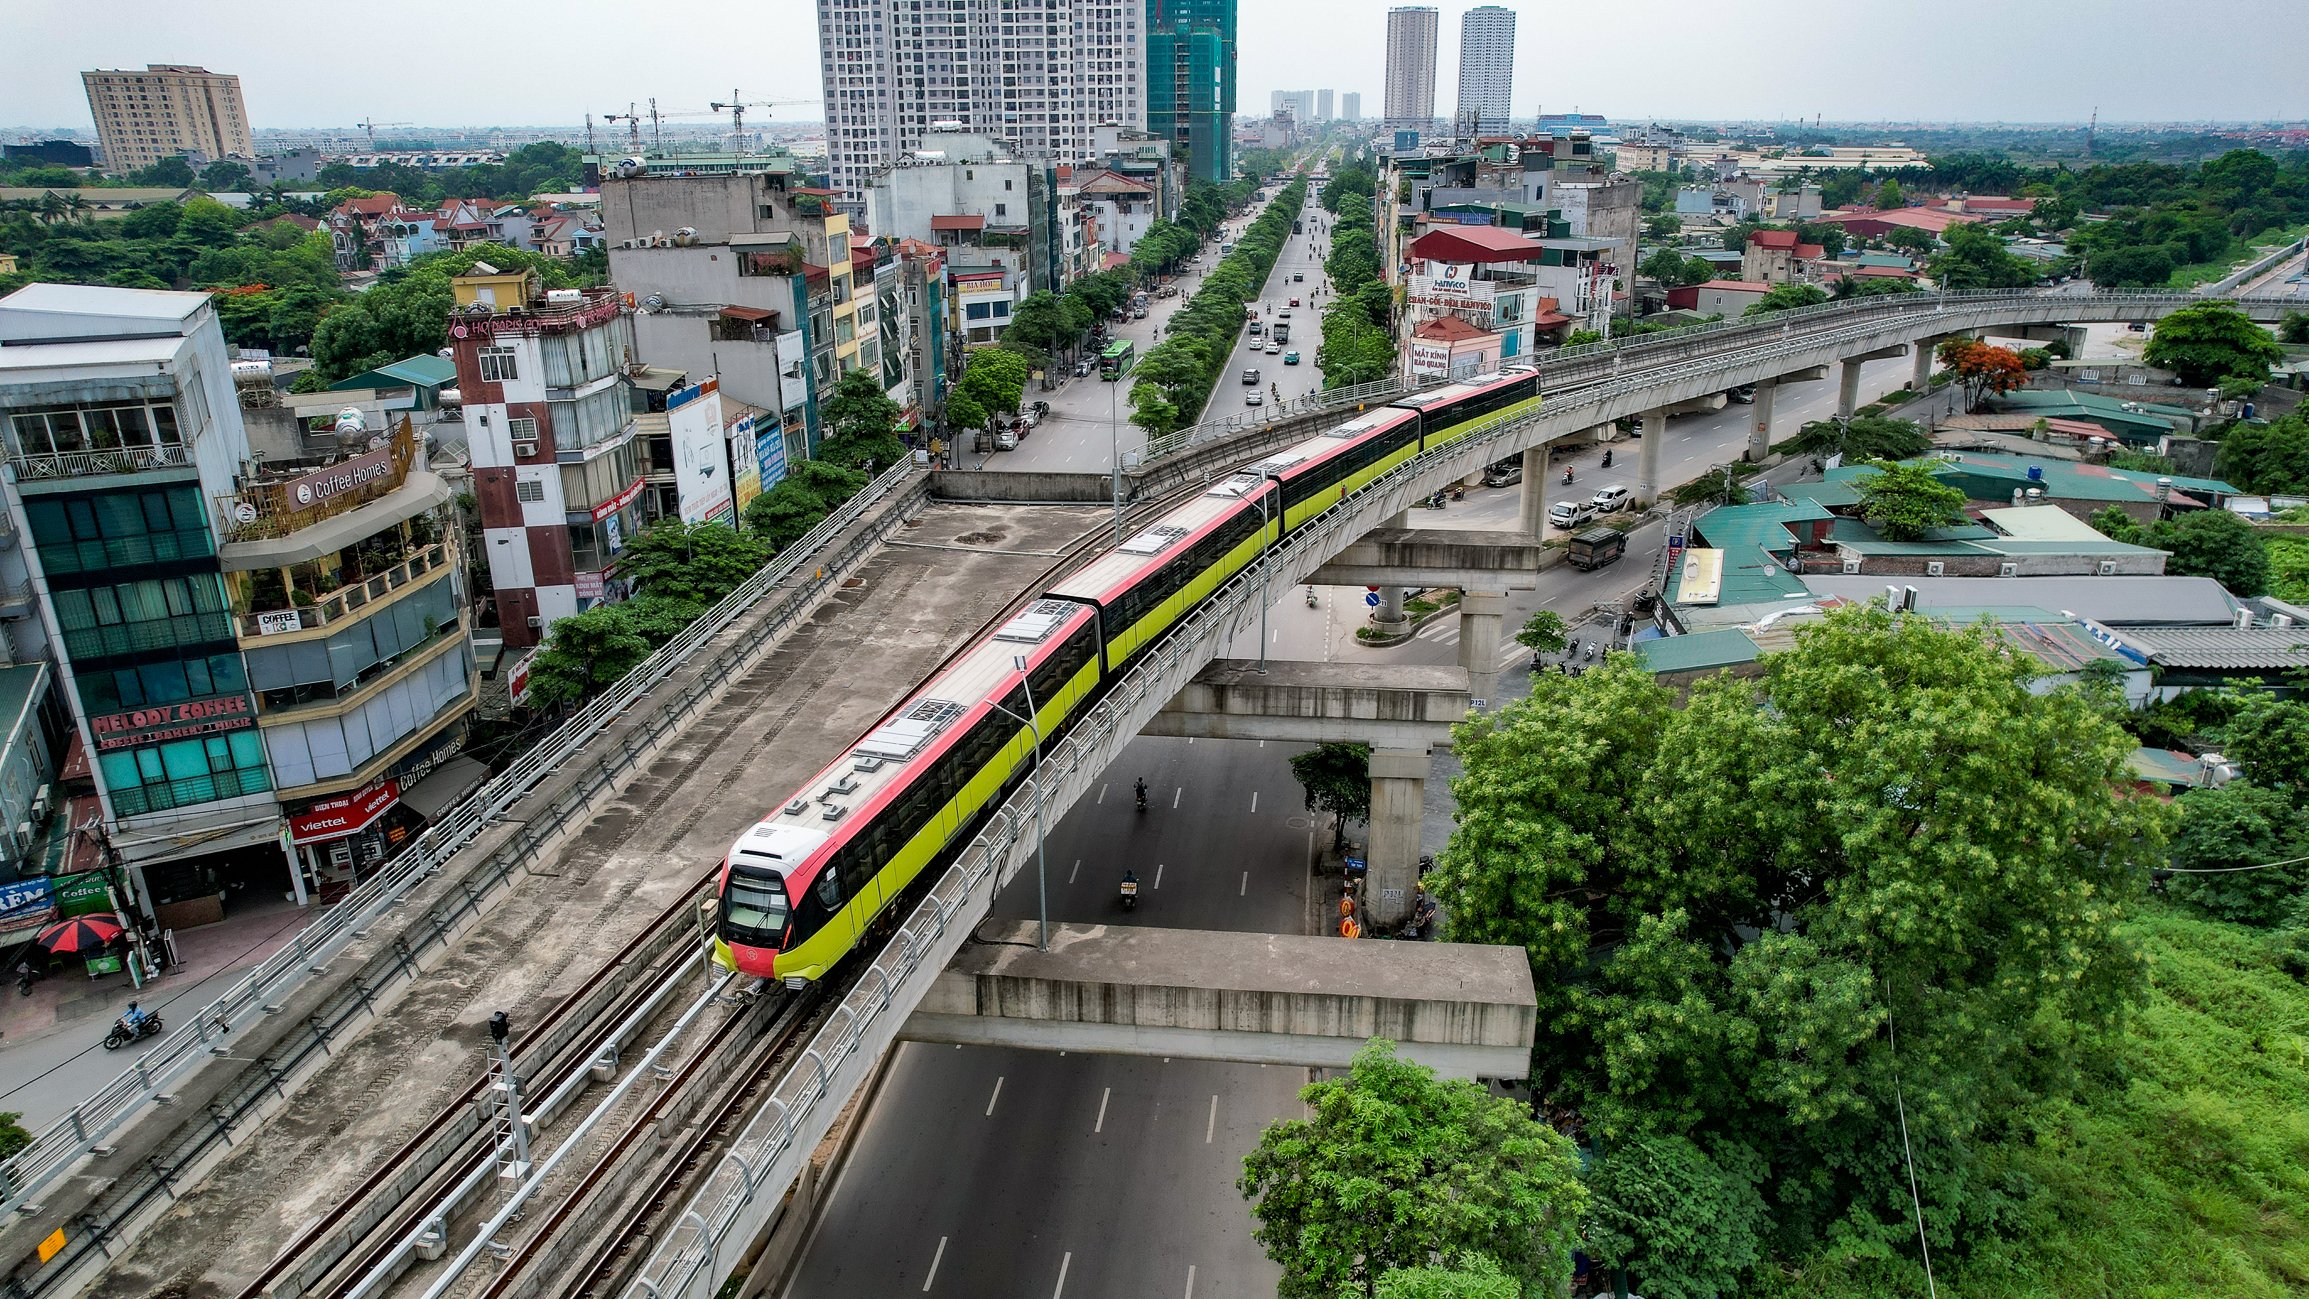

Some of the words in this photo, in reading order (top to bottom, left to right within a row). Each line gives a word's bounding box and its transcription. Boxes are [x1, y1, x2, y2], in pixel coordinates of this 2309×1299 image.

[1461, 300, 1492, 311] HANVICO
[491, 319, 522, 333] PARIS
[1430, 350, 1447, 360] KÍNH
[315, 473, 352, 498] Coffee
[353, 460, 387, 484] Homes
[262, 611, 296, 624] COFFEE
[91, 706, 172, 735] MELODY
[179, 694, 248, 720] COFFEE
[100, 735, 145, 750] COFFEE
[154, 725, 204, 741] BAKERY
[215, 716, 252, 731] MUSIC
[399, 760, 432, 792] Coffee
[431, 738, 462, 768] Homes
[364, 790, 390, 813] viettel
[436, 795, 461, 818] COFFEE
[461, 775, 485, 797] HOMES
[300, 816, 348, 832] viettel
[62, 887, 101, 898] Coffee
